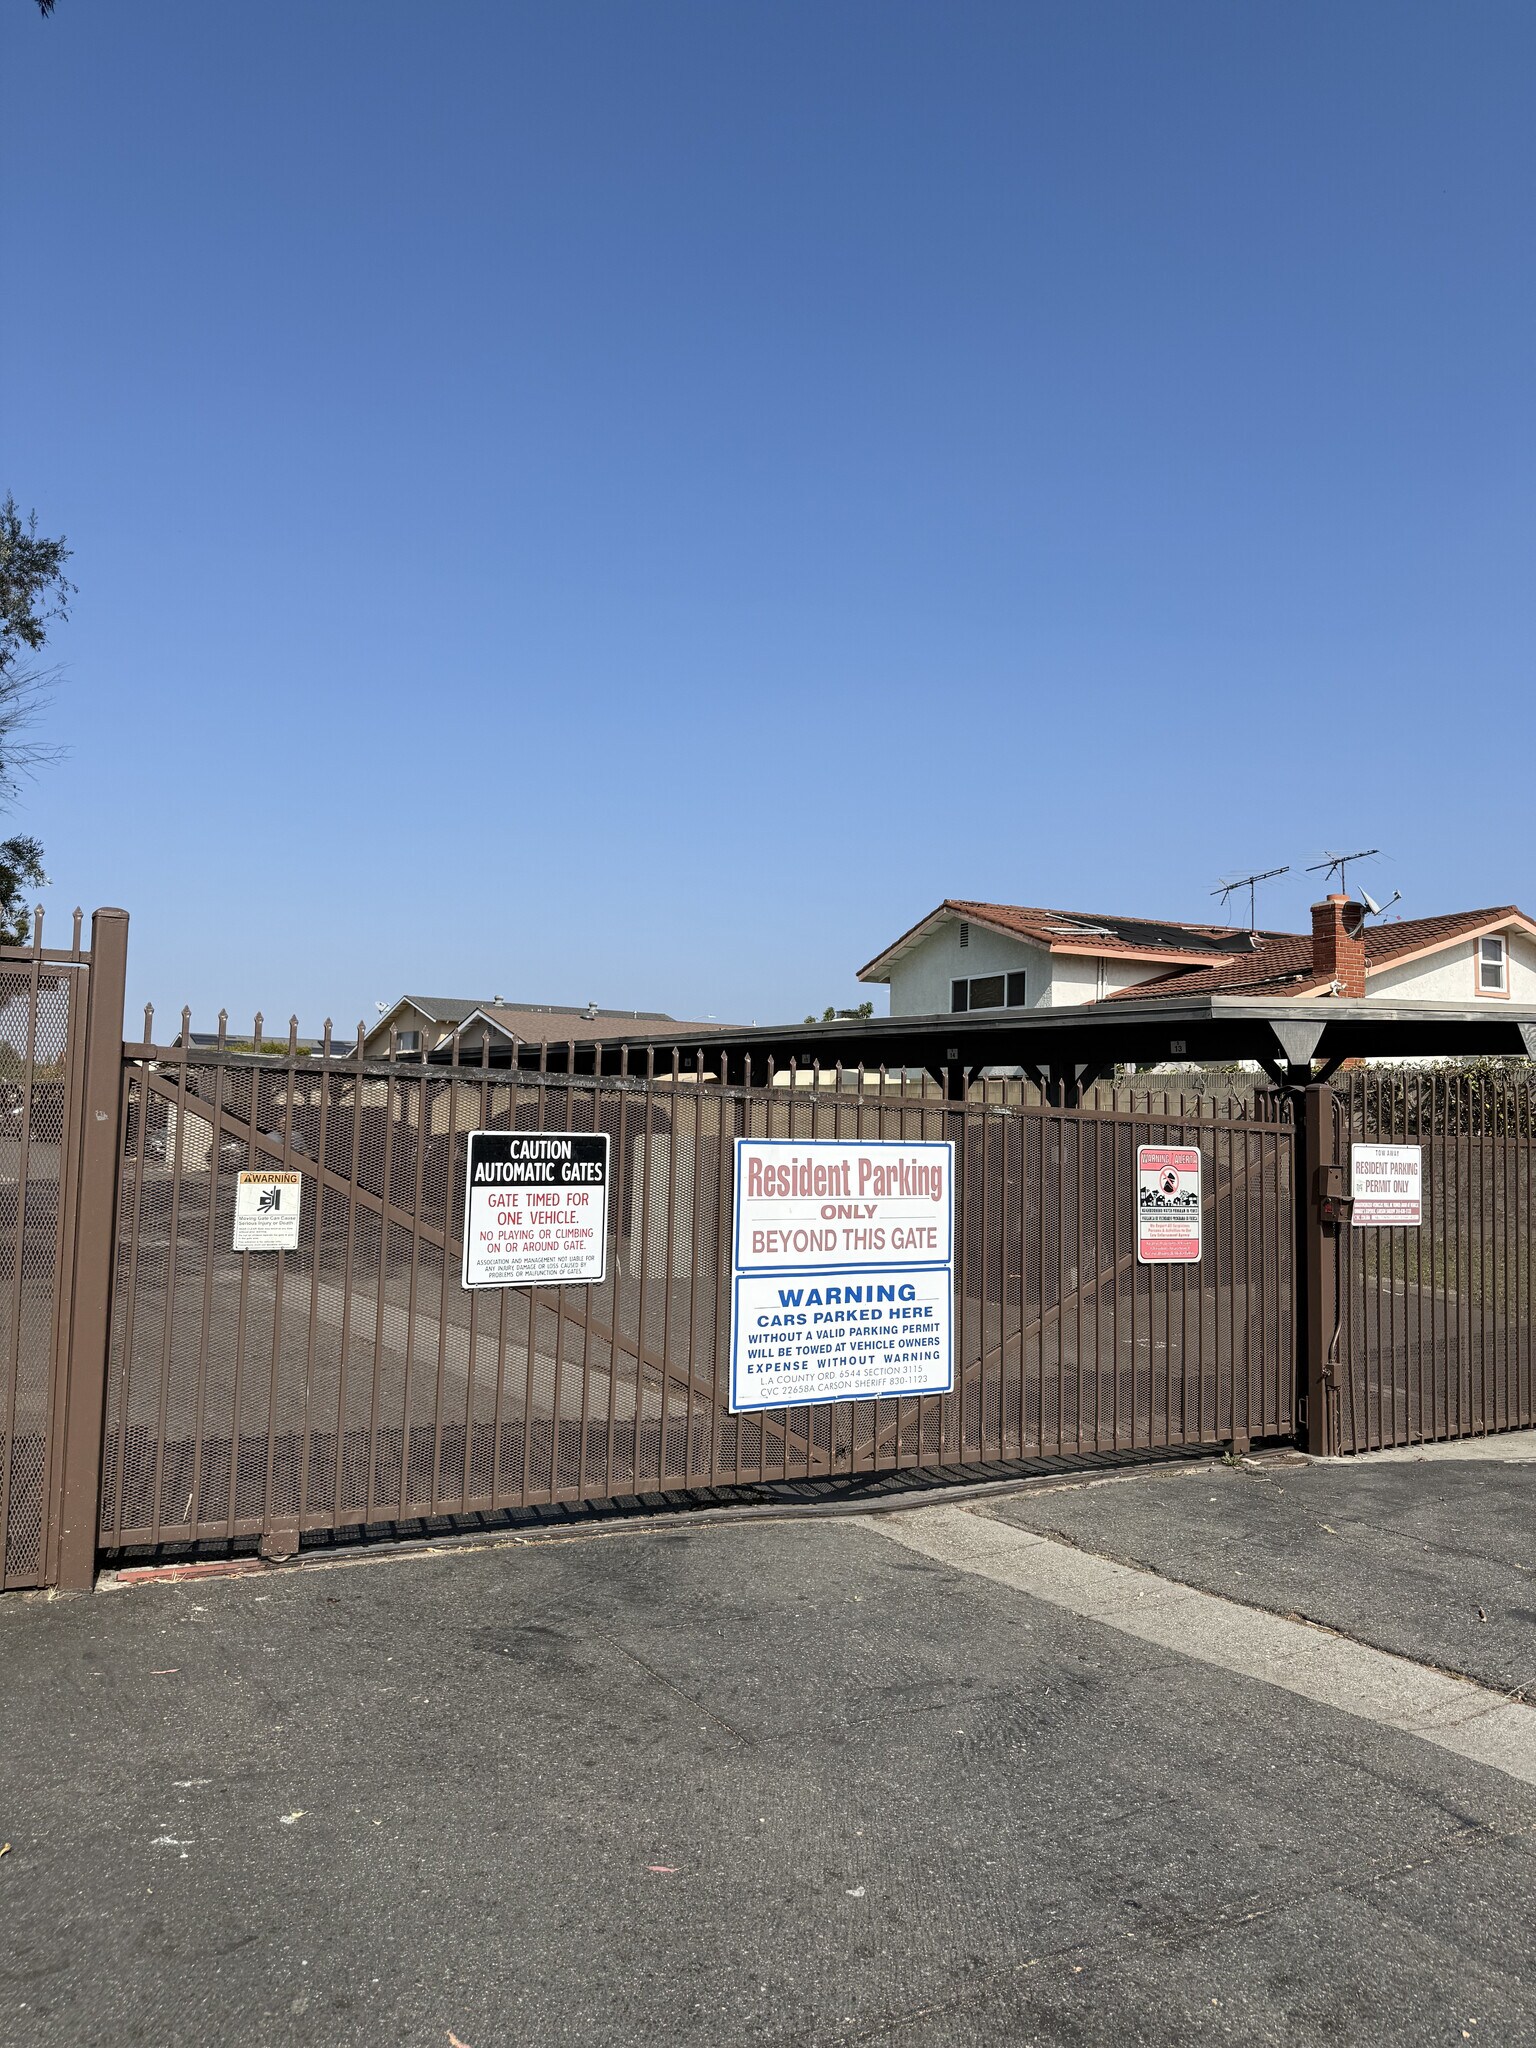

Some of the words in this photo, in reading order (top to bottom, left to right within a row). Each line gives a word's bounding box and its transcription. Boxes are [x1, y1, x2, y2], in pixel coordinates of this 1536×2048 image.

[510, 1140, 571, 1159] CAUTION
[1142, 1153, 1169, 1164] WARNING
[1174, 1153, 1197, 1165] ALERTA
[474, 1162, 555, 1182] AUTOMATIC
[562, 1162, 602, 1181] GATES
[1356, 1161, 1388, 1174] RESIDENT
[1390, 1162, 1418, 1175] PARKING
[253, 1175, 297, 1183] WARNING
[748, 1157, 851, 1197] Resident
[858, 1158, 942, 1202] Parking
[1366, 1180, 1391, 1192] PERMIT
[1393, 1180, 1409, 1193] ONLY
[488, 1194, 518, 1207] GATE
[526, 1193, 560, 1206] TIMED
[567, 1193, 589, 1206] FOR
[497, 1211, 523, 1225] ONE
[530, 1211, 579, 1225] VEHICLE.
[820, 1204, 878, 1220] ONLY
[480, 1231, 493, 1241] NO
[498, 1230, 534, 1240] PLAYING
[539, 1229, 551, 1239] OR
[555, 1228, 594, 1238] CLIMBING
[752, 1230, 837, 1253] BEYOND
[843, 1228, 885, 1250] THIS
[891, 1227, 937, 1250] GATE
[487, 1243, 500, 1253] ON
[506, 1243, 518, 1252] OR
[523, 1241, 559, 1252] AROUND
[564, 1240, 586, 1250] GATE.
[778, 1284, 916, 1308] WARNING
[757, 1313, 807, 1328] CARS
[814, 1309, 883, 1324] PARKED
[889, 1306, 933, 1320] HERE
[748, 1331, 802, 1344] WITHOUT
[806, 1331, 813, 1340] A
[816, 1329, 845, 1340] VALID
[850, 1325, 898, 1337] PARKING
[902, 1323, 940, 1334] PERMIT
[748, 1348, 774, 1359] WILL
[778, 1347, 792, 1357] BE
[796, 1345, 831, 1355] TOWED
[835, 1343, 847, 1352] AT
[850, 1340, 895, 1350] VEHICLE
[899, 1337, 940, 1348] OWNERS
[747, 1360, 808, 1374] EXPENSE
[817, 1355, 875, 1368] WITHOUT
[884, 1351, 940, 1363] WARNING
[777, 1373, 815, 1385] COUNTY
[818, 1371, 838, 1381] ORD.
[839, 1369, 861, 1378] 6544
[864, 1366, 900, 1377] SECTION
[903, 1365, 923, 1374] 3115
[760, 1388, 779, 1397] CVC
[782, 1385, 815, 1395] 22658A
[818, 1381, 852, 1392] CARSON
[855, 1378, 887, 1388] SHERIFF
[889, 1375, 928, 1386] 830-1123
